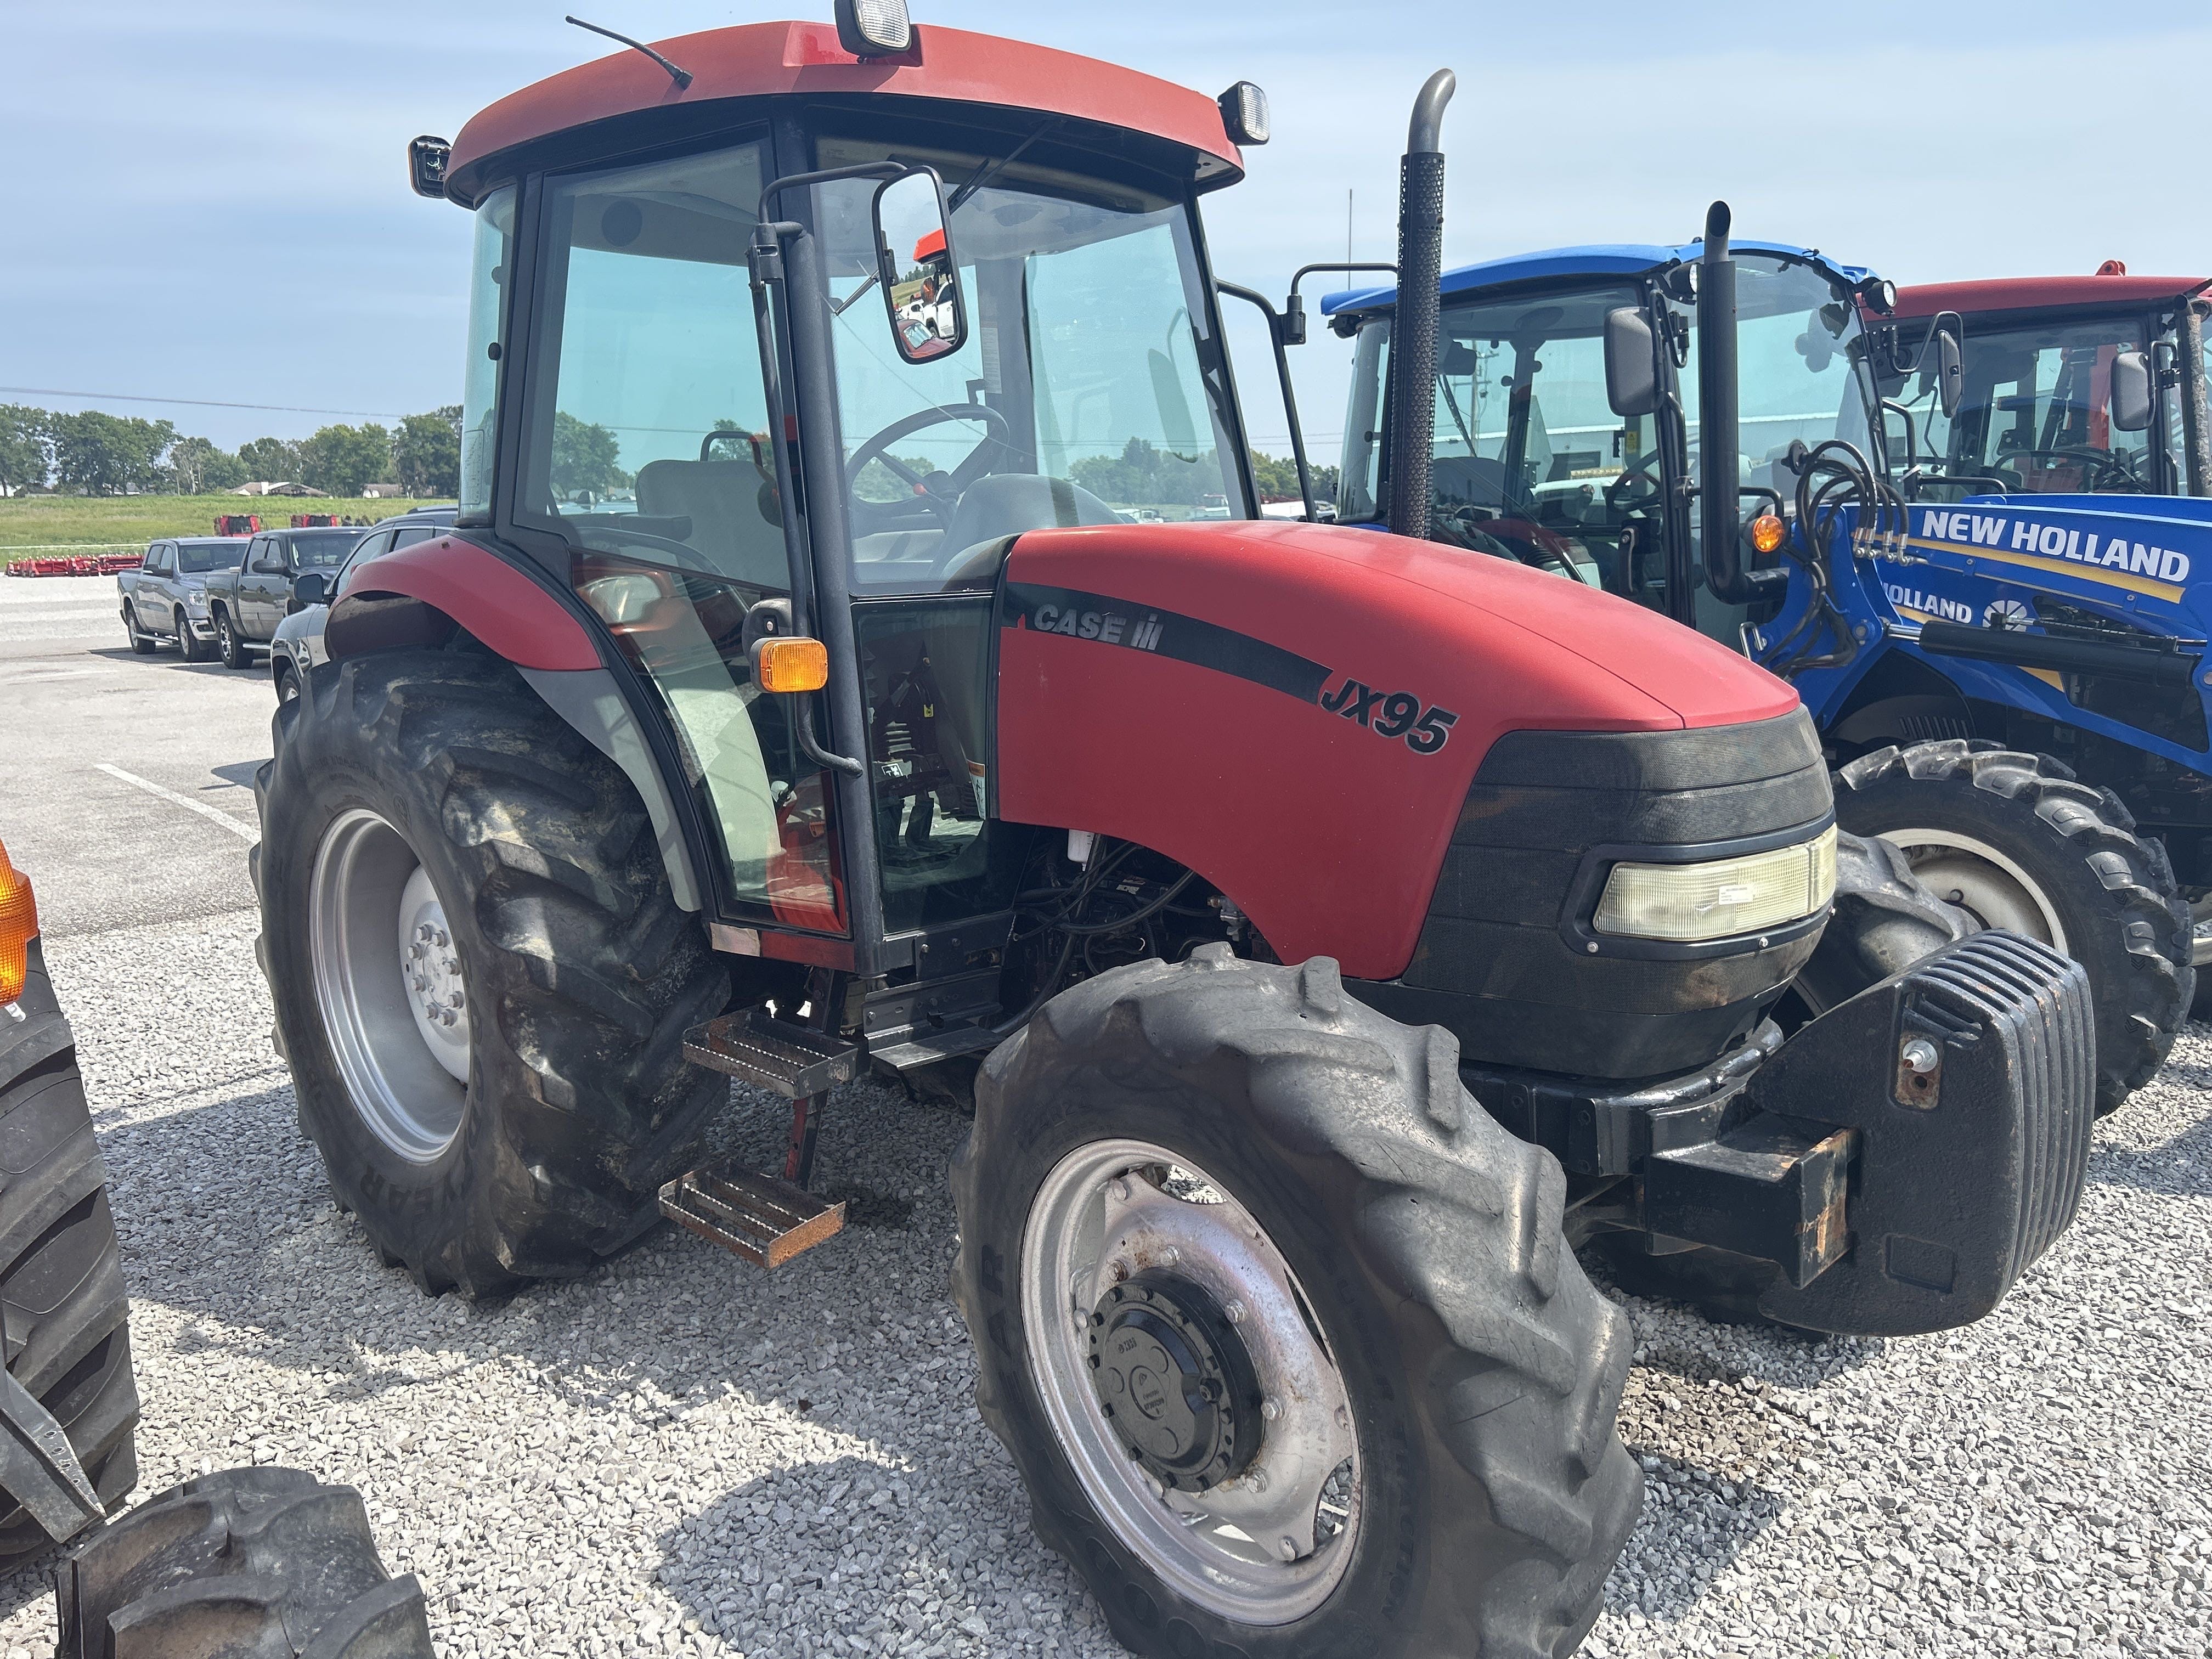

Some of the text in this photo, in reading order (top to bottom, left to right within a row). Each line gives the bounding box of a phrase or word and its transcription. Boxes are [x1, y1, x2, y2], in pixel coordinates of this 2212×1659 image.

[1921, 510, 2190, 583] NEW HOLLAND
[1034, 603, 1127, 644] CASE
[1319, 676, 1461, 755] JX95
[359, 939, 485, 1216] GOODYEAR
